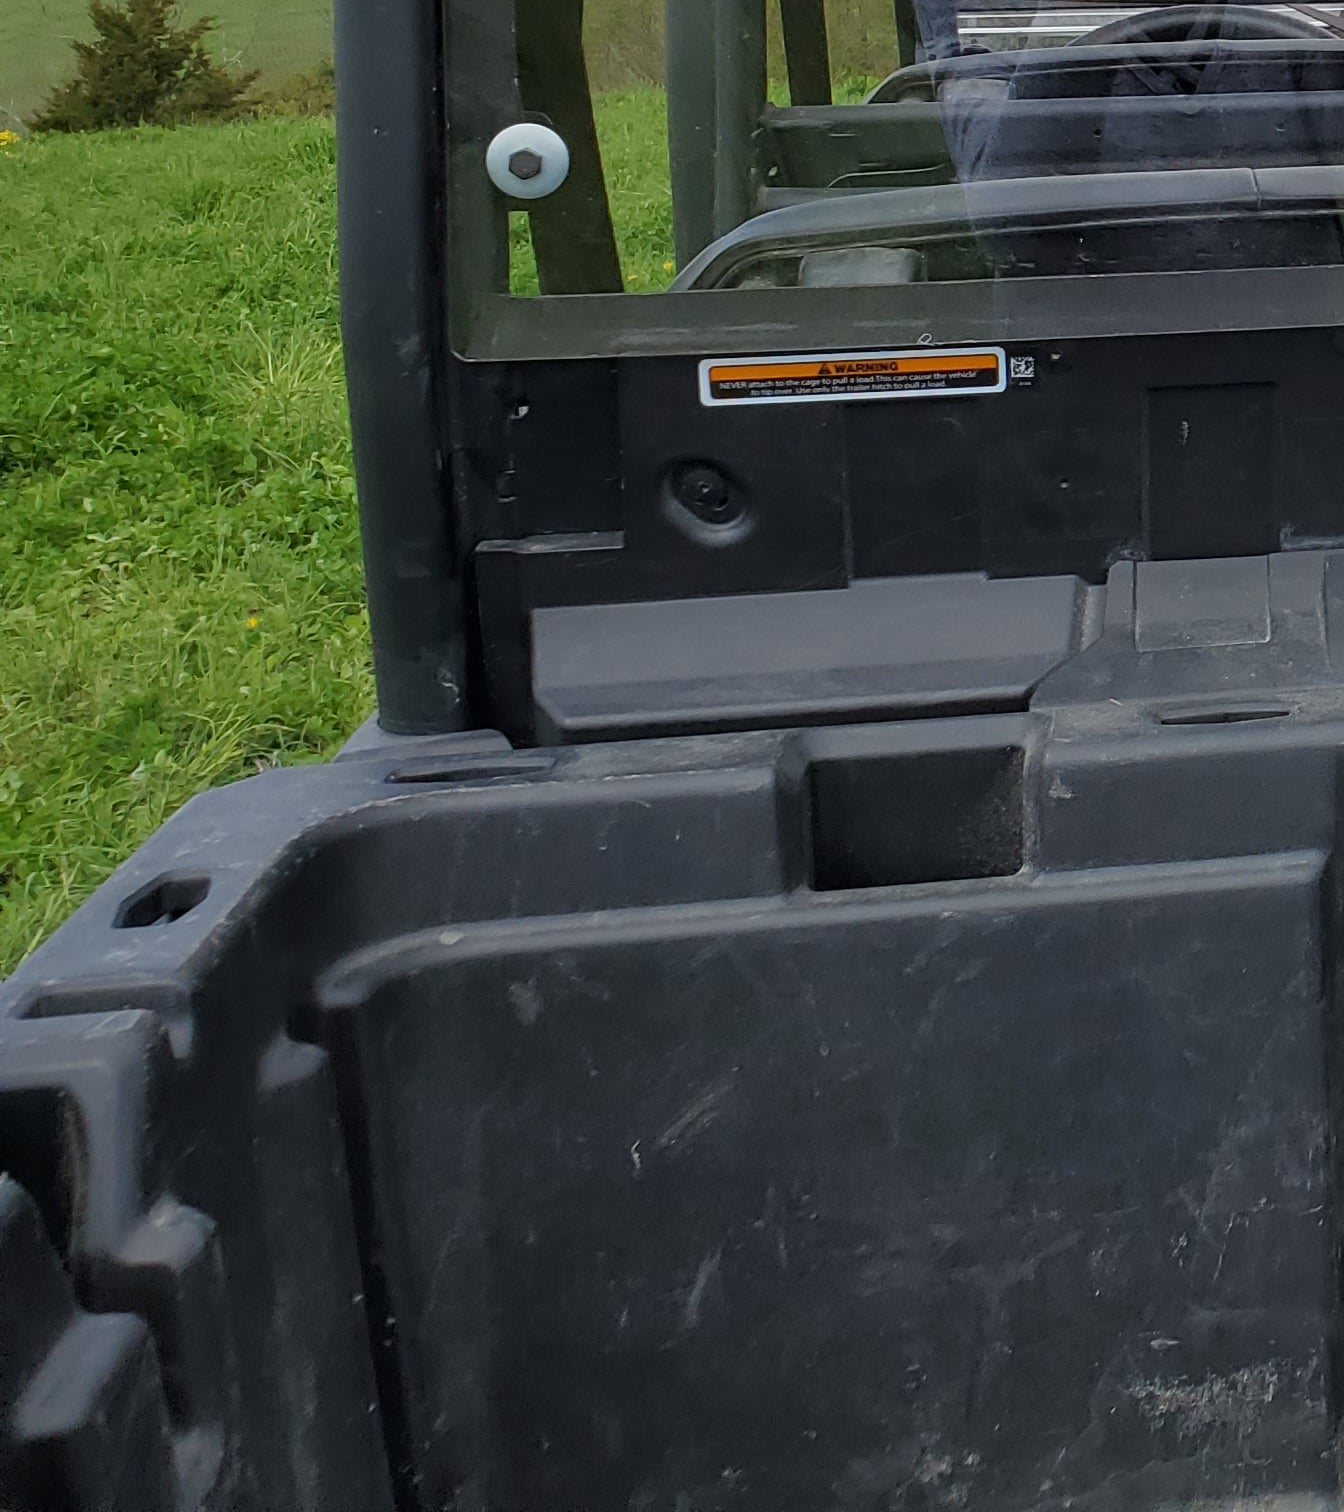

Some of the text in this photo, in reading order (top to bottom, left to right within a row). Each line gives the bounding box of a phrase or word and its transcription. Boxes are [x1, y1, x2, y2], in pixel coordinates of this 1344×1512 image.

[833, 362, 899, 373] WARNING
[801, 379, 820, 387] cage
[832, 376, 847, 385] pull
[948, 370, 976, 378] vehicle
